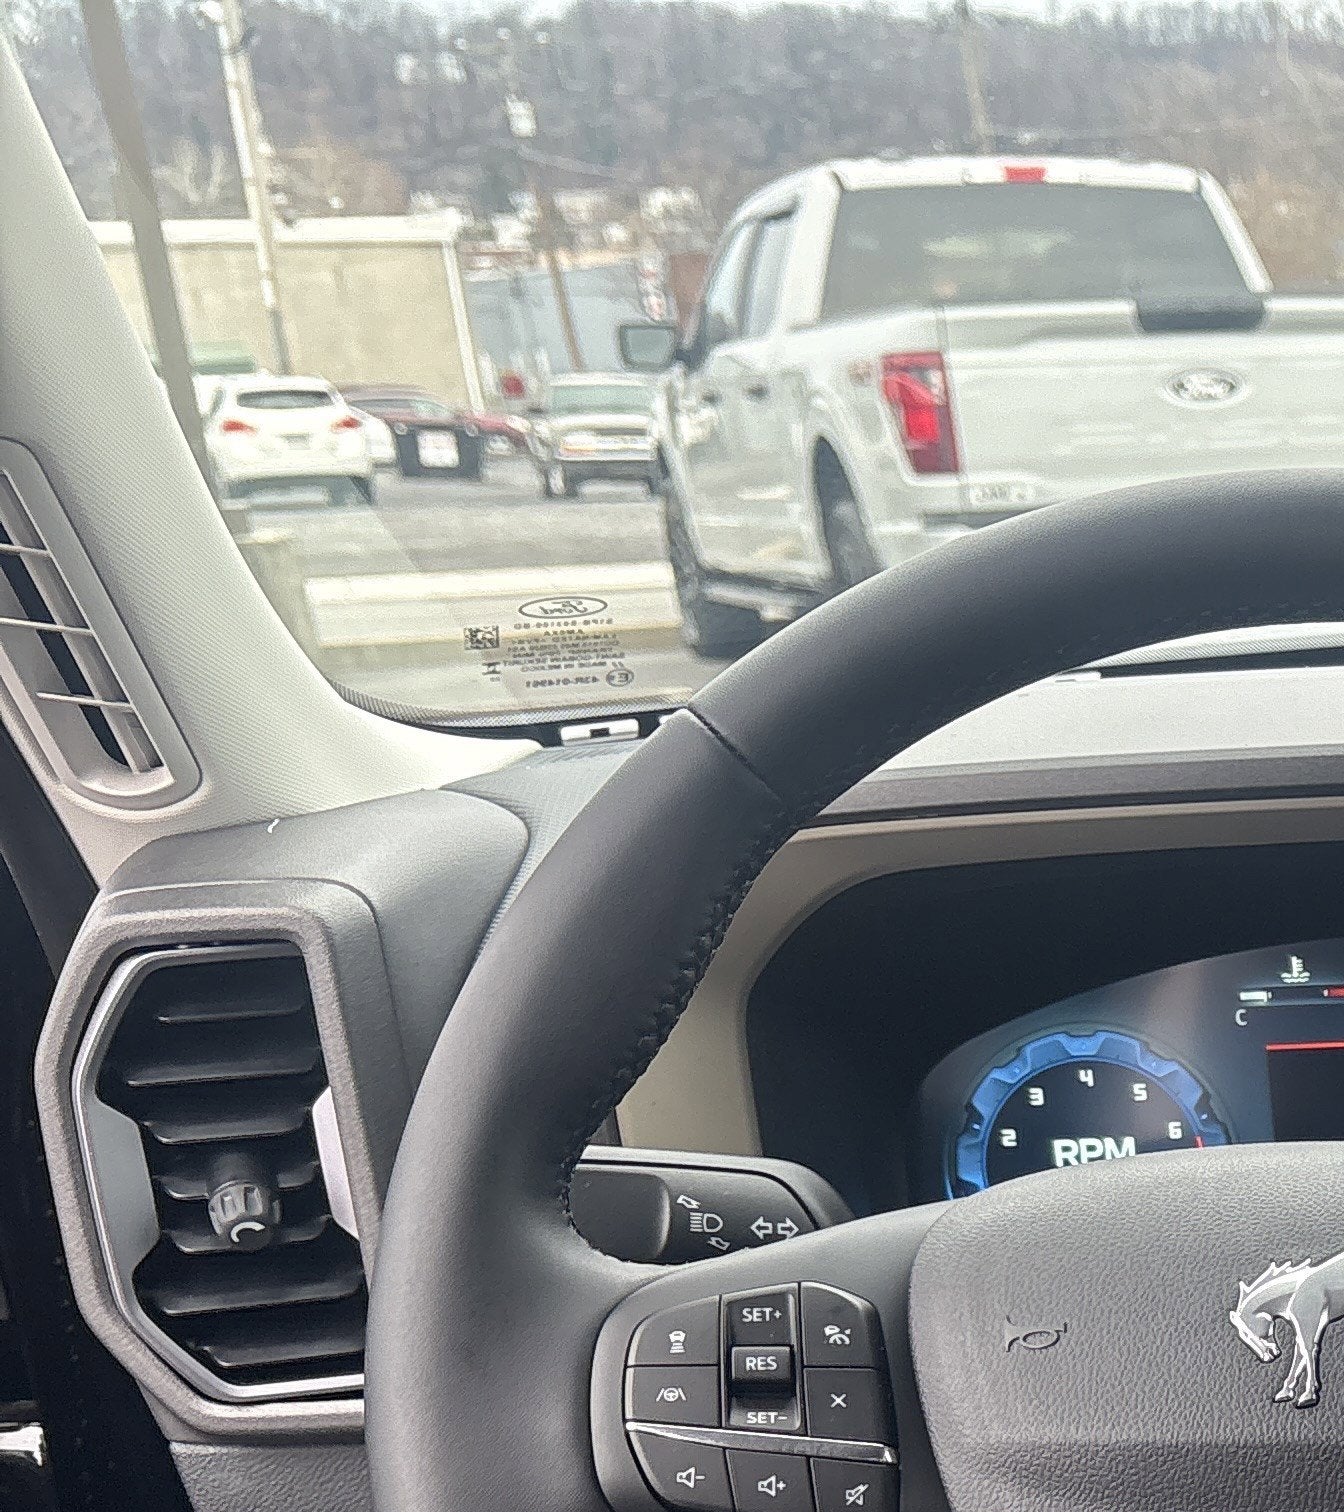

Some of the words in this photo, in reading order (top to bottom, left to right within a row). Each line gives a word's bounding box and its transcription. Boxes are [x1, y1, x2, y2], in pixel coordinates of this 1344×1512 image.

[1235, 1008, 1248, 1026] C
[1079, 1068, 1095, 1087] 4
[1029, 1087, 1045, 1106] 3
[1133, 1083, 1148, 1101] 5
[1000, 1128, 1018, 1147] 2
[1167, 1121, 1183, 1139] 6
[1052, 1136, 1137, 1168] RPM
[745, 1356, 778, 1372] RES
